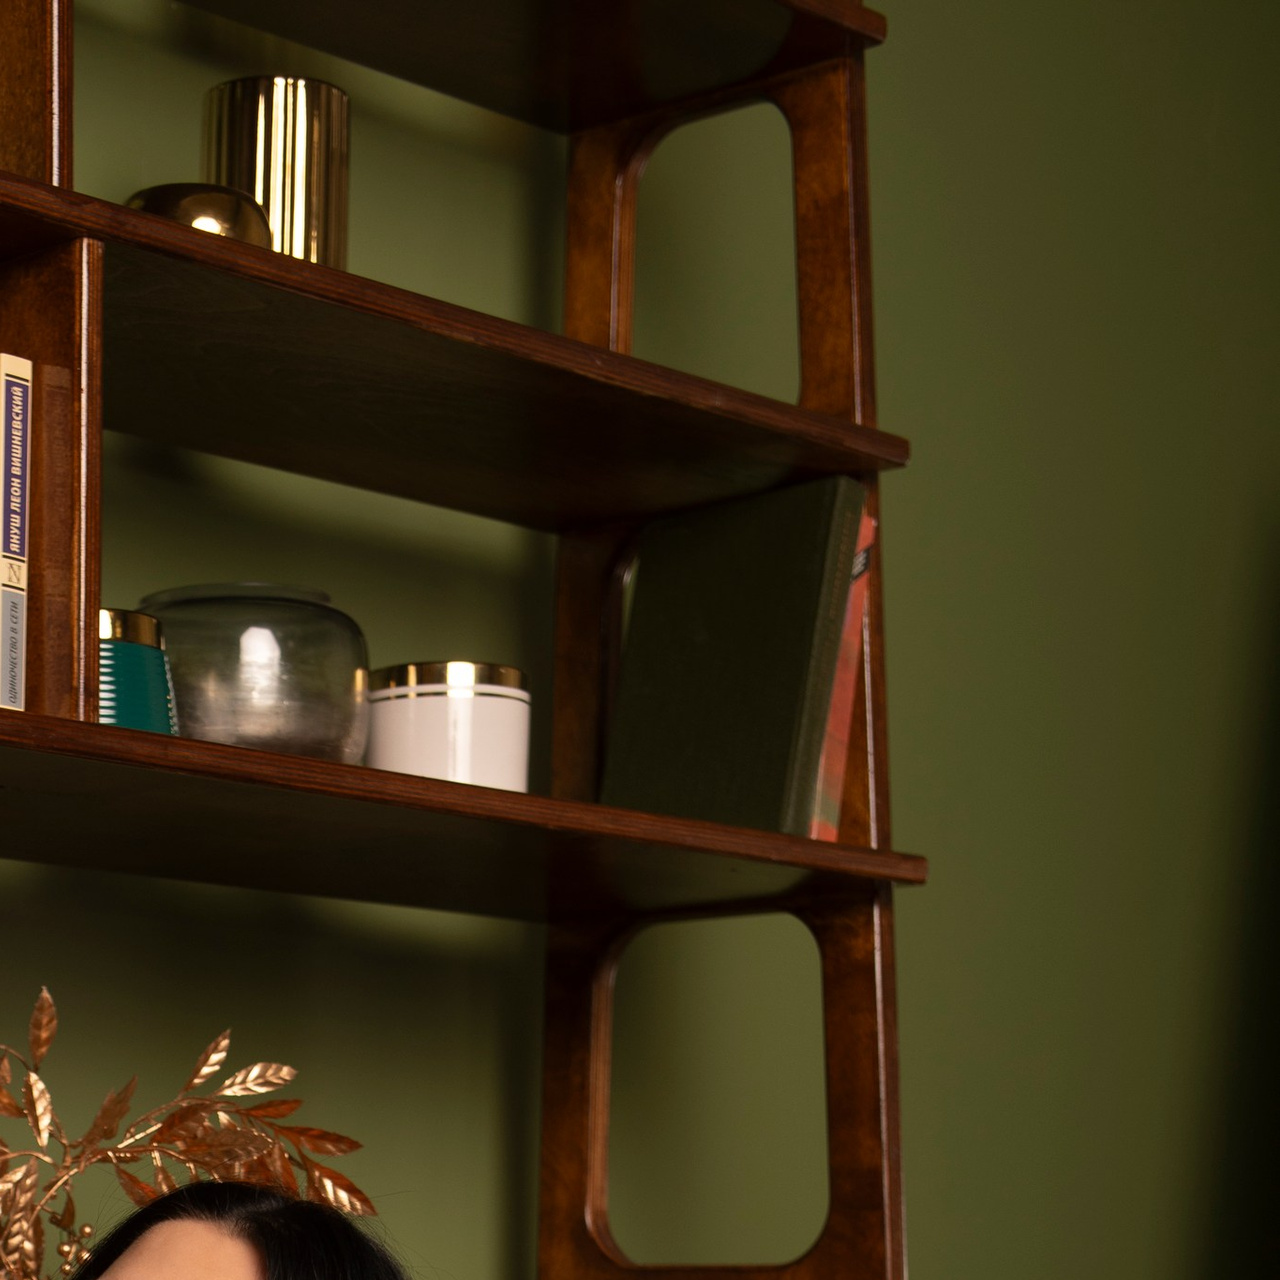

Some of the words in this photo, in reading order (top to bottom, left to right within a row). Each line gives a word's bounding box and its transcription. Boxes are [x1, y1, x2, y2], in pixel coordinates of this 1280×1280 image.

[11, 386, 24, 475] ВИШНЕВСКИЙ
[10, 477, 22, 512] ЛЕОН
[9, 514, 21, 552] ЯНУШ
[10, 601, 19, 625] СЕТИ
[9, 636, 19, 704] ОДИНОЧЕСТВО
